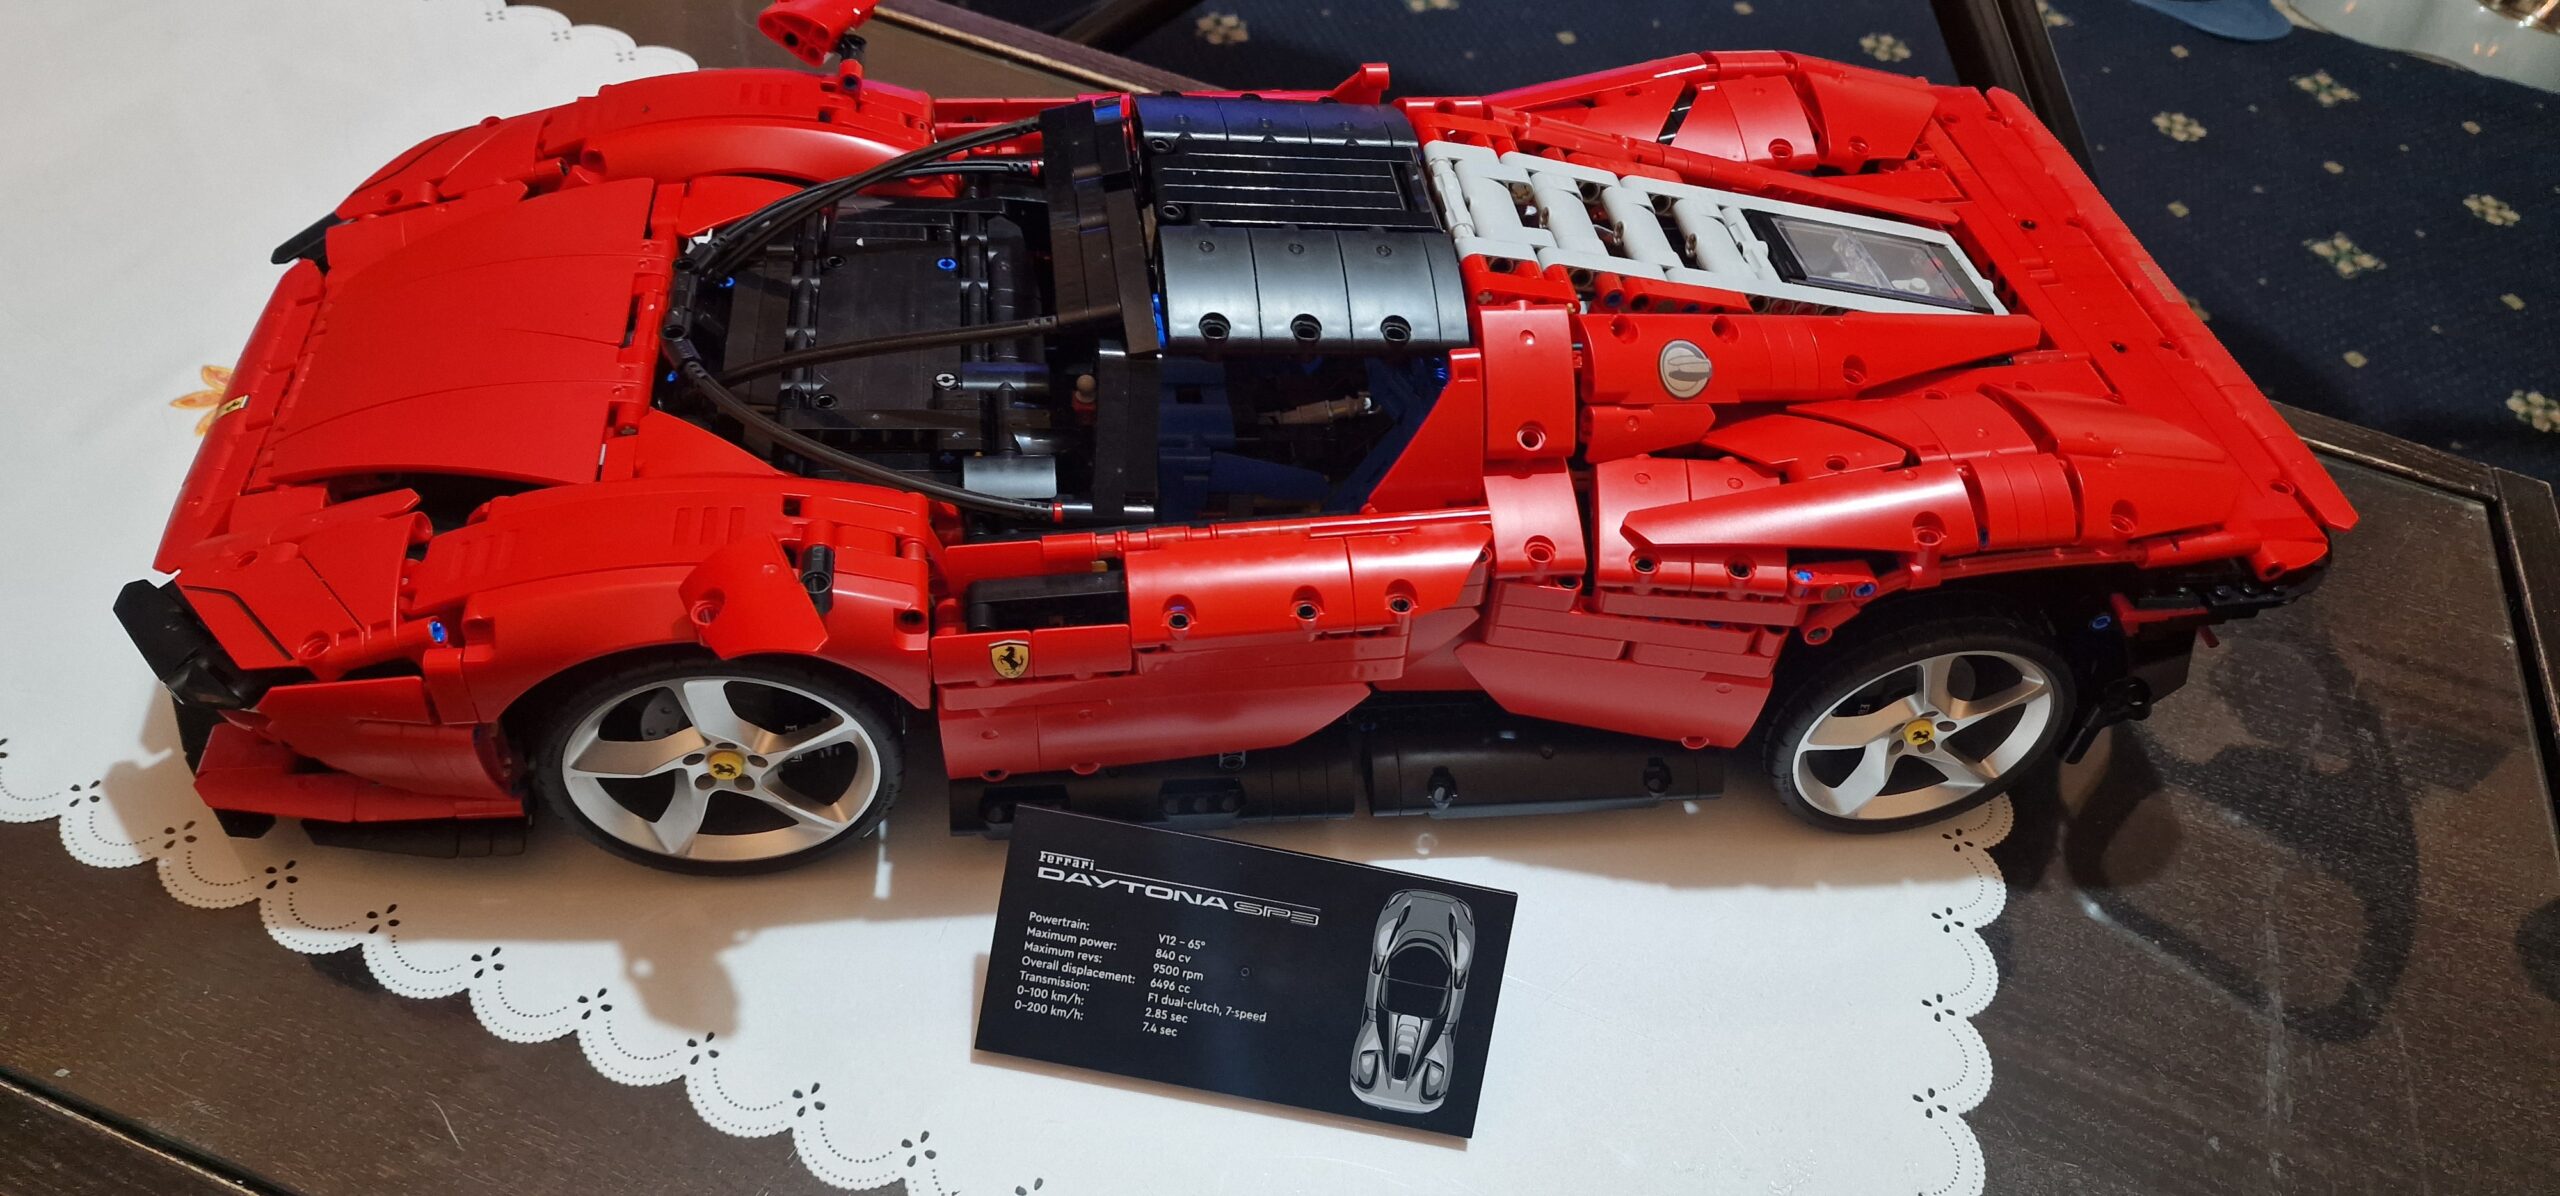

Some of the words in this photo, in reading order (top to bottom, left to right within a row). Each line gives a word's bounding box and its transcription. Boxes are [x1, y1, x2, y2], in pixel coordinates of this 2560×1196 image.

[1038, 851, 1095, 870] Ferrari
[1038, 867, 1228, 909] DAYTONA
[1233, 900, 1320, 926] SP3
[1029, 912, 1090, 930] Powertrain:
[1026, 926, 1076, 943] Maximum
[1080, 936, 1117, 950] power:
[1159, 933, 1176, 946] V12
[1024, 941, 1074, 959] Maximum
[1077, 951, 1102, 963] revs:
[1155, 949, 1175, 960] 840
[1179, 954, 1191, 964] cv
[1022, 956, 1059, 970] Overall
[1061, 962, 1135, 984] displacement:
[1153, 963, 1179, 977] 9500
[1182, 970, 1203, 981] rpm
[1020, 971, 1090, 991] Transmission:
[1150, 978, 1175, 991] 6496
[1178, 984, 1190, 993] cc
[1051, 990, 1084, 1005] km/h:
[1051, 1005, 1084, 1021] km/h:
[1145, 1007, 1167, 1020] 2.85
[1170, 1013, 1188, 1024] sec
[1148, 993, 1158, 1003] F1
[1161, 994, 1222, 1016] dual-clutch,
[1225, 1006, 1267, 1022] 7-speed
[1142, 1022, 1157, 1034] 7.4
[1160, 1027, 1177, 1037] sec
